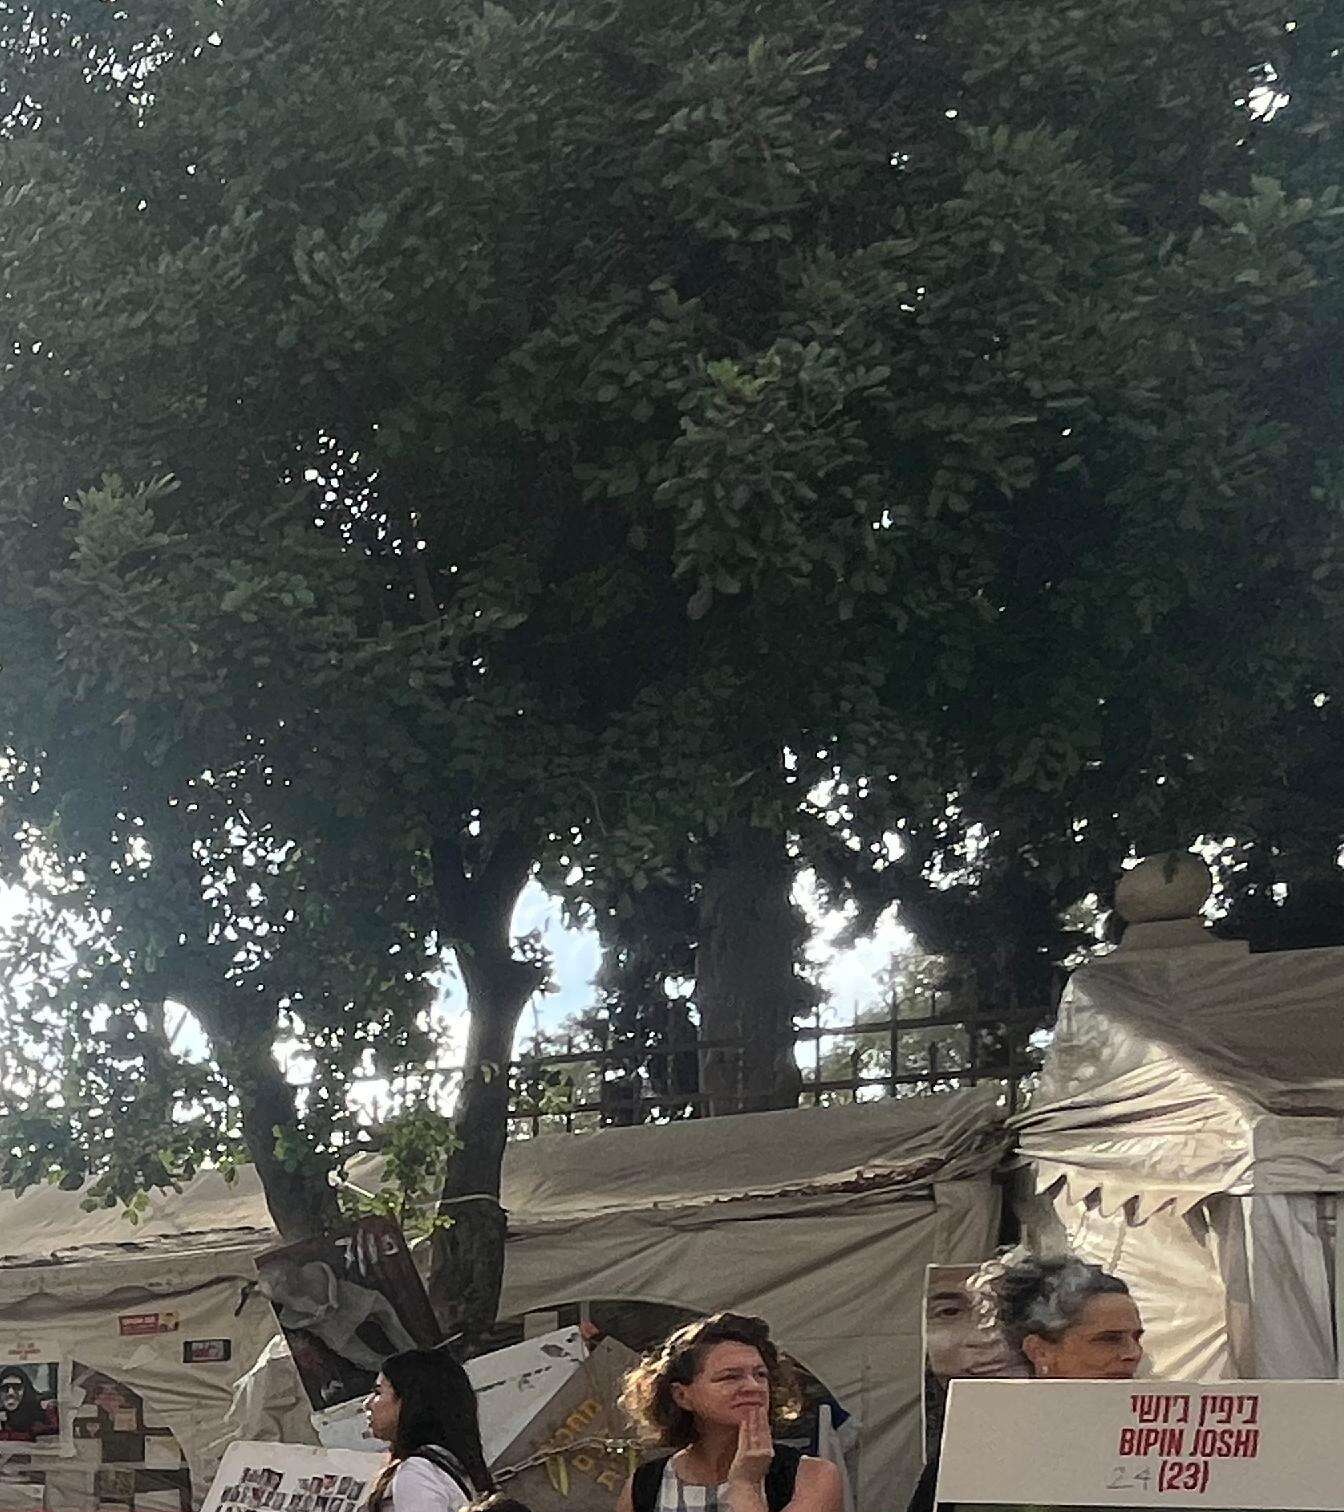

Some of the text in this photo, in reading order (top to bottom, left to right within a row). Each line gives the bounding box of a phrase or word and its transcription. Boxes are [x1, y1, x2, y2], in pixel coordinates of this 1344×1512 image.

[1199, 1395, 1259, 1427] ביפין
[1119, 1428, 1259, 1458] BIPIN JOSHI
[1159, 1460, 1209, 1493] (23)
